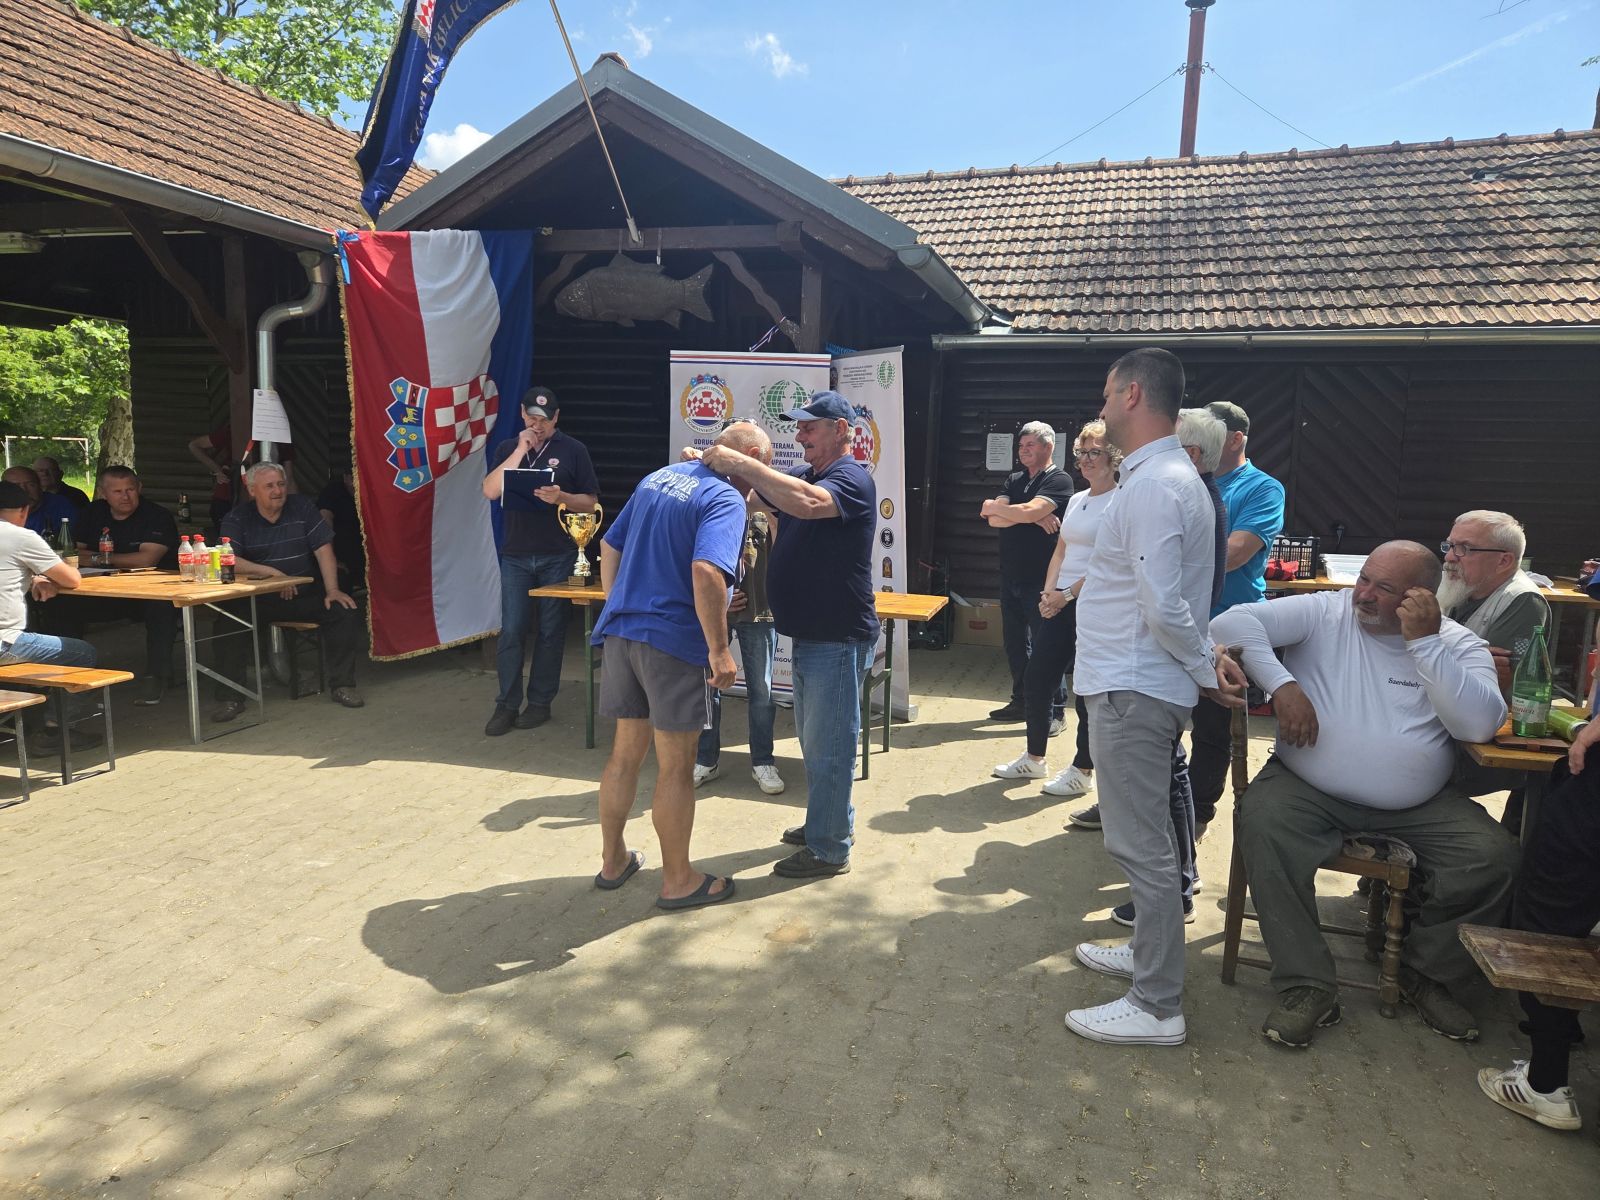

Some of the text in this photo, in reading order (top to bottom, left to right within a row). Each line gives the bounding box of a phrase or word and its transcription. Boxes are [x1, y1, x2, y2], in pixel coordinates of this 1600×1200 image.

[434, 0, 471, 49] BELIC
[693, 438, 795, 450] UDRUG TERANA
[774, 451, 803, 459] HRVATSKE
[771, 459, 794, 467] UPANIJE
